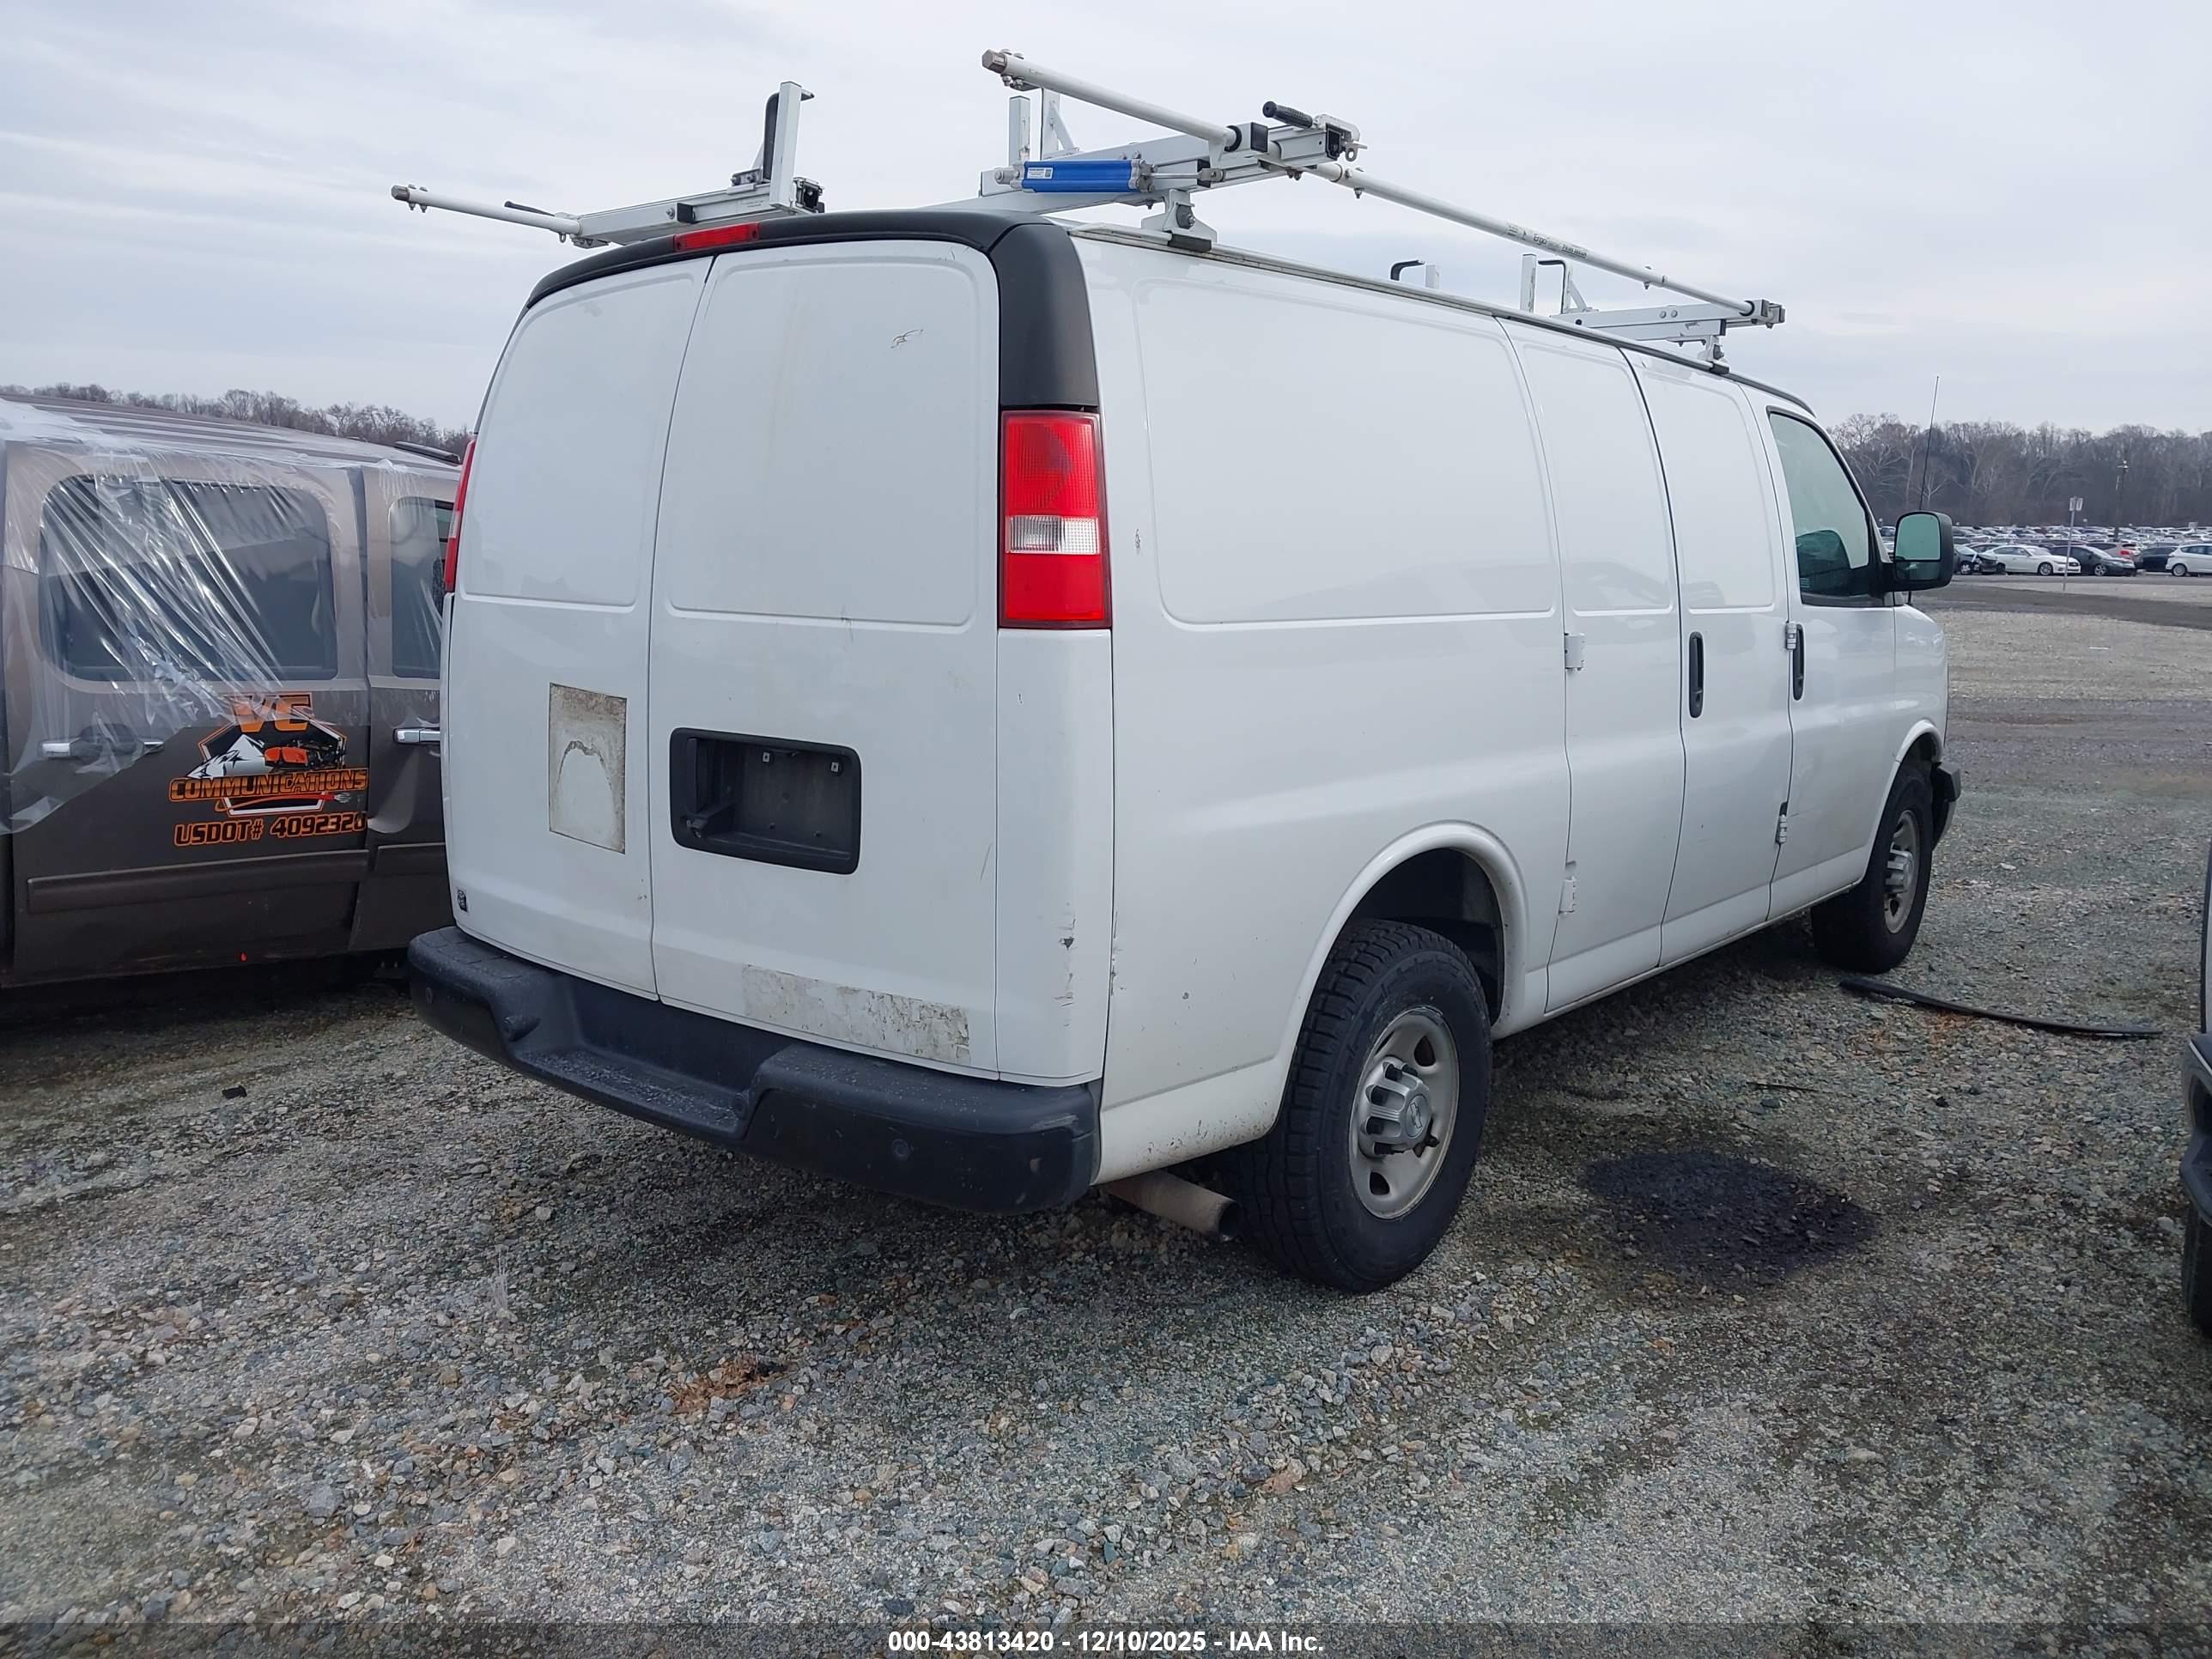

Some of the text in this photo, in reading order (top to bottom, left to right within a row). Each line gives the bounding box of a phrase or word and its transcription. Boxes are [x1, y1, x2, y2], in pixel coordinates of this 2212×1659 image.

[169, 769, 368, 802] COMMUNICATIONS
[174, 811, 368, 847] USDOT# 4092320
